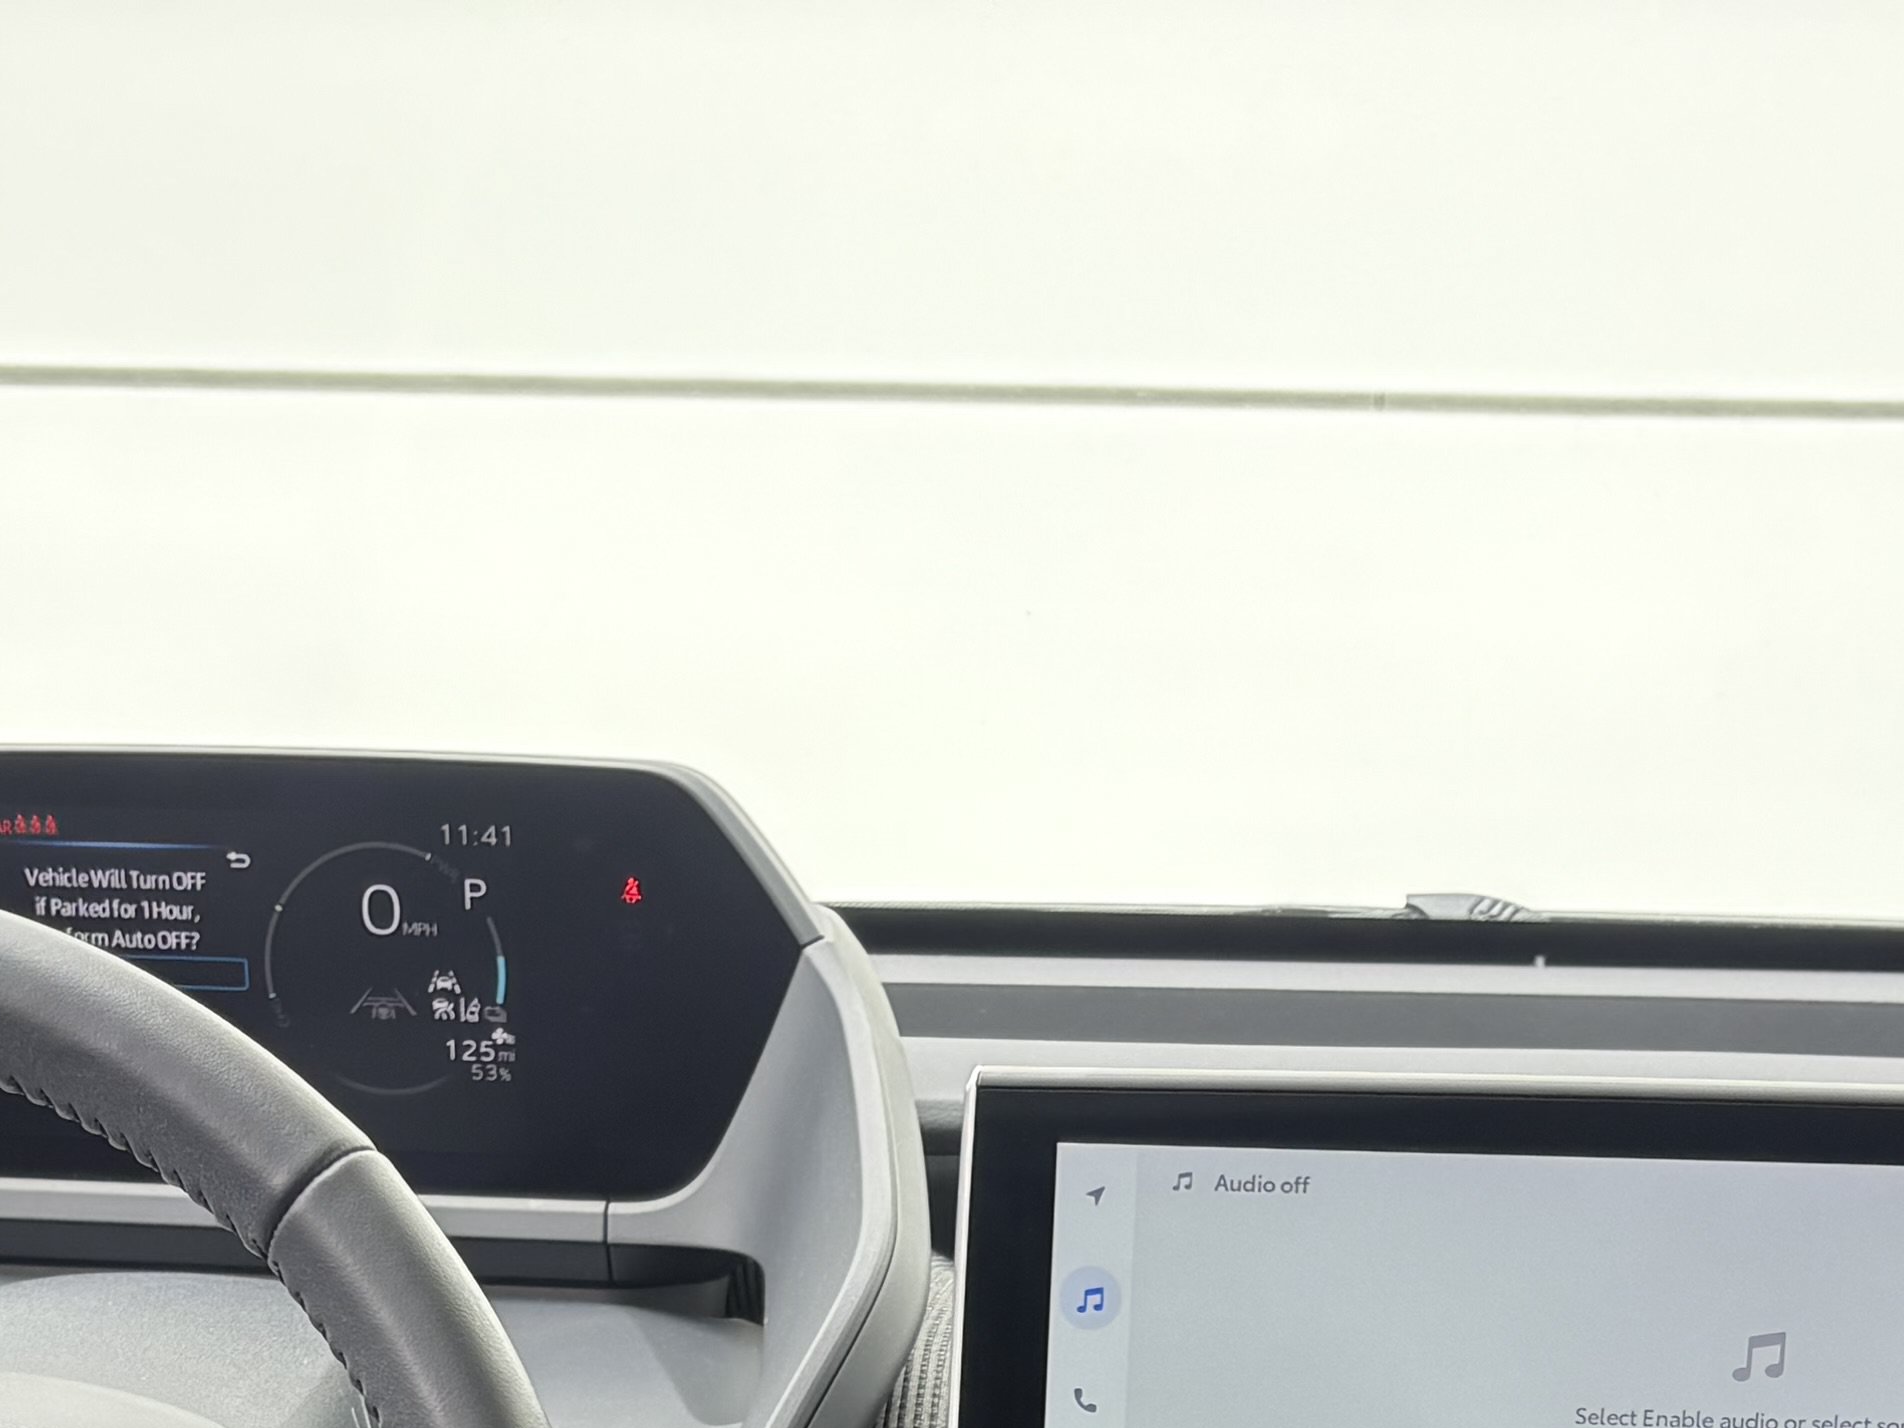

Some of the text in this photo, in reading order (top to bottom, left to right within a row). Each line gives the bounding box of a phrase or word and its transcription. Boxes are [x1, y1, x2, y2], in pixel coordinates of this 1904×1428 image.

[440, 823, 511, 847] 11:41
[24, 867, 206, 891] Vehicle Will Turn OFF
[464, 878, 487, 910] P
[35, 896, 200, 923] if Parked for 1 Hour,
[361, 883, 437, 937] 0 MPH
[112, 930, 156, 949] Auto
[157, 931, 200, 951] OFF?
[446, 1039, 516, 1062] 125 mi
[471, 1064, 512, 1082] 53%
[1213, 1173, 1312, 1195] Audio off
[1574, 1406, 1638, 1428] Select
